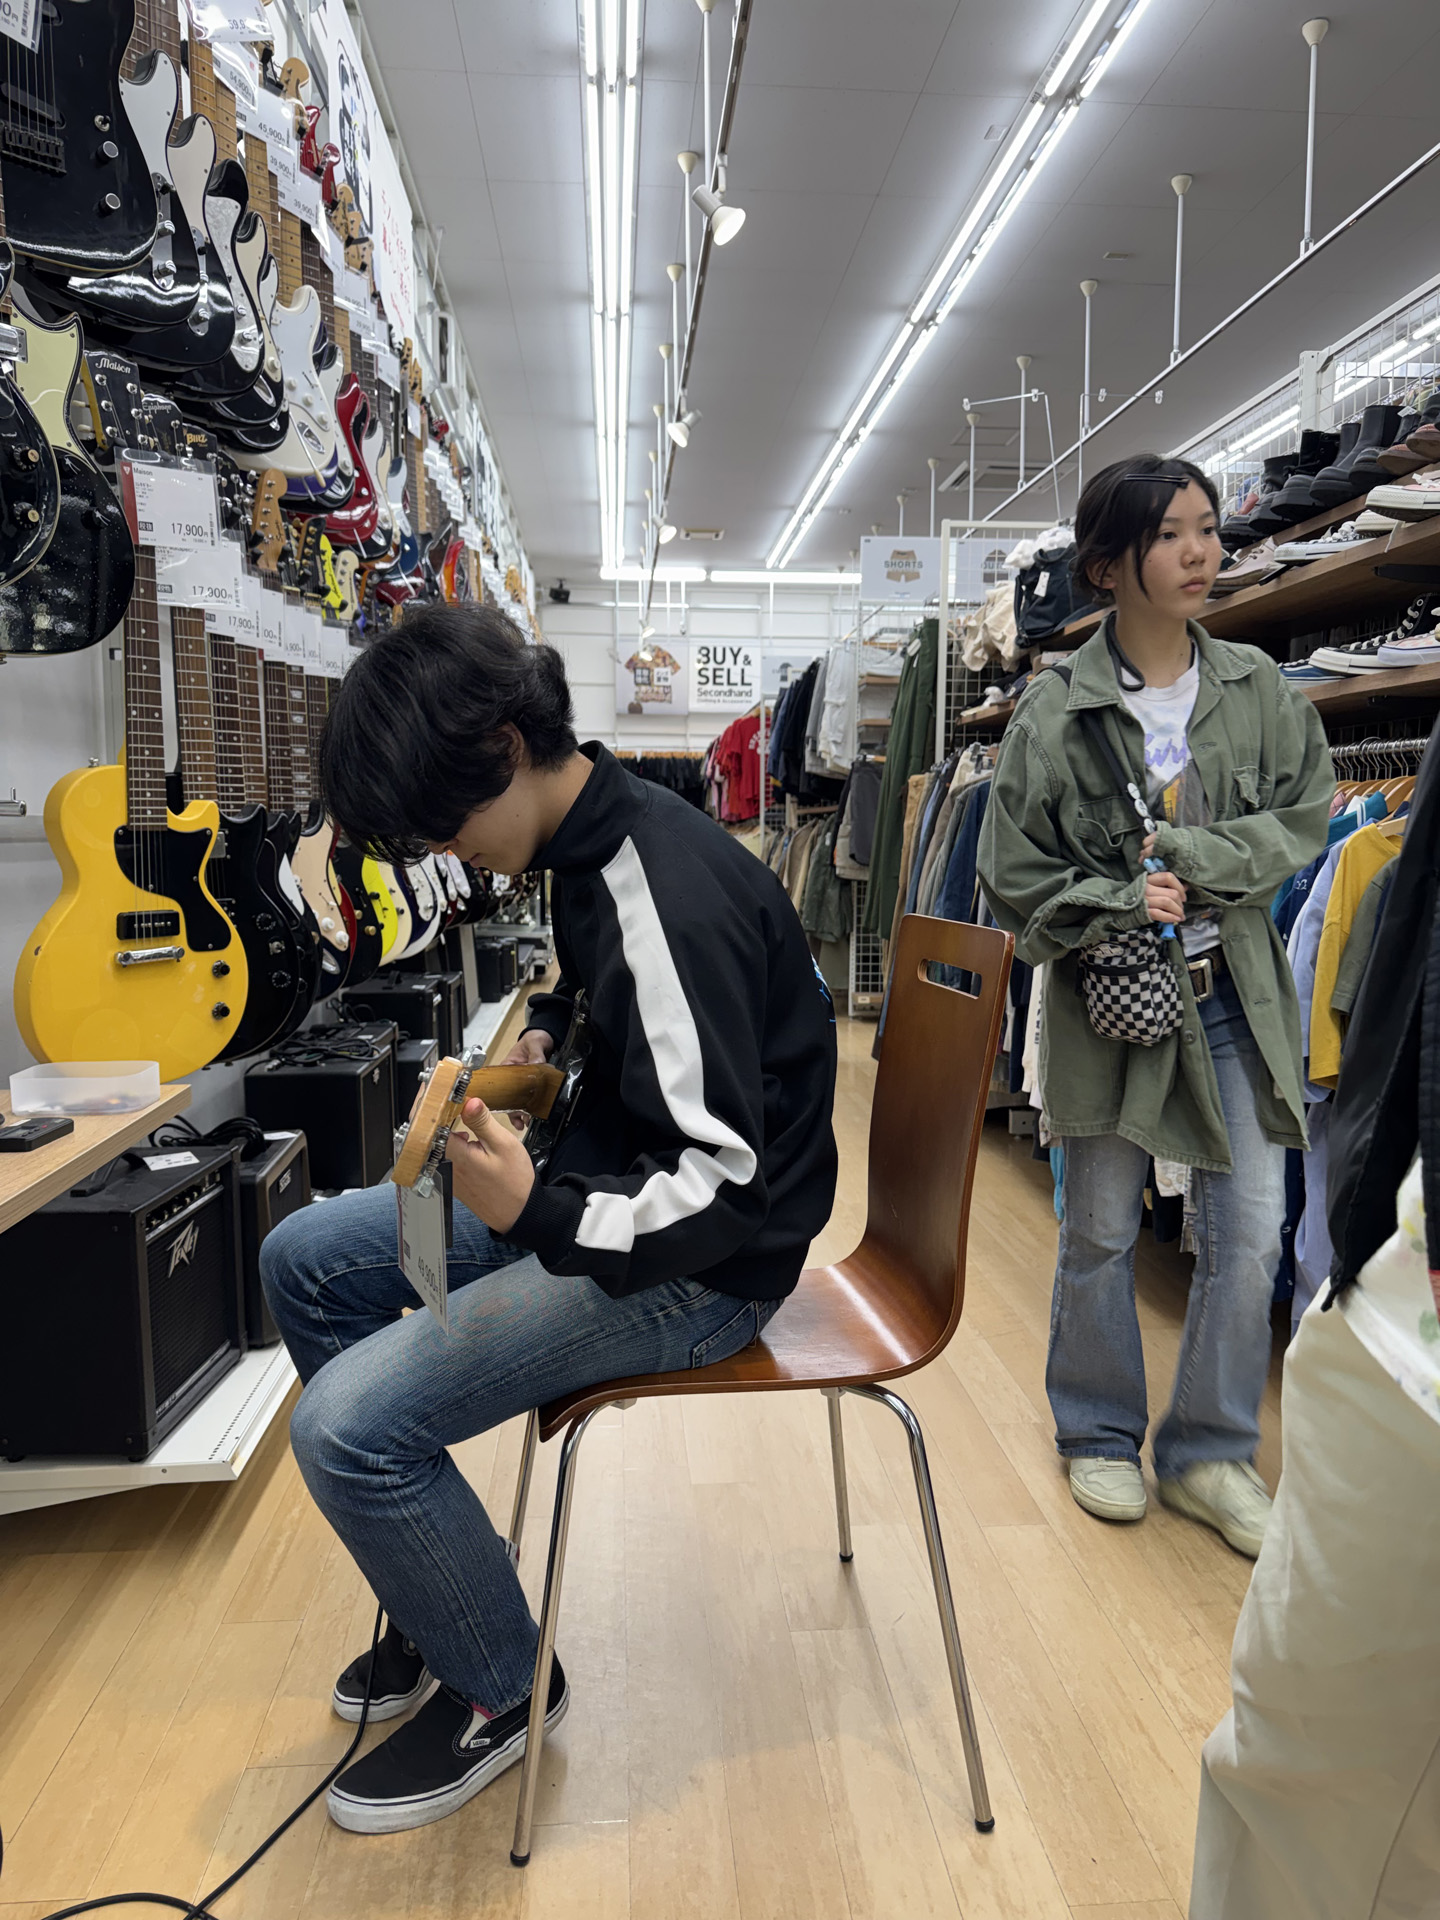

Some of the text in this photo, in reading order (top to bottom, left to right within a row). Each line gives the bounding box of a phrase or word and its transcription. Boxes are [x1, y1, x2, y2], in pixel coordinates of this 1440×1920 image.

[95, 357, 131, 374] Maison
[133, 467, 153, 476] Maison
[171, 522, 208, 538] 17,900円
[884, 560, 923, 569] SHORTS
[697, 667, 752, 687] SELL
[697, 687, 753, 698] Secondhand
